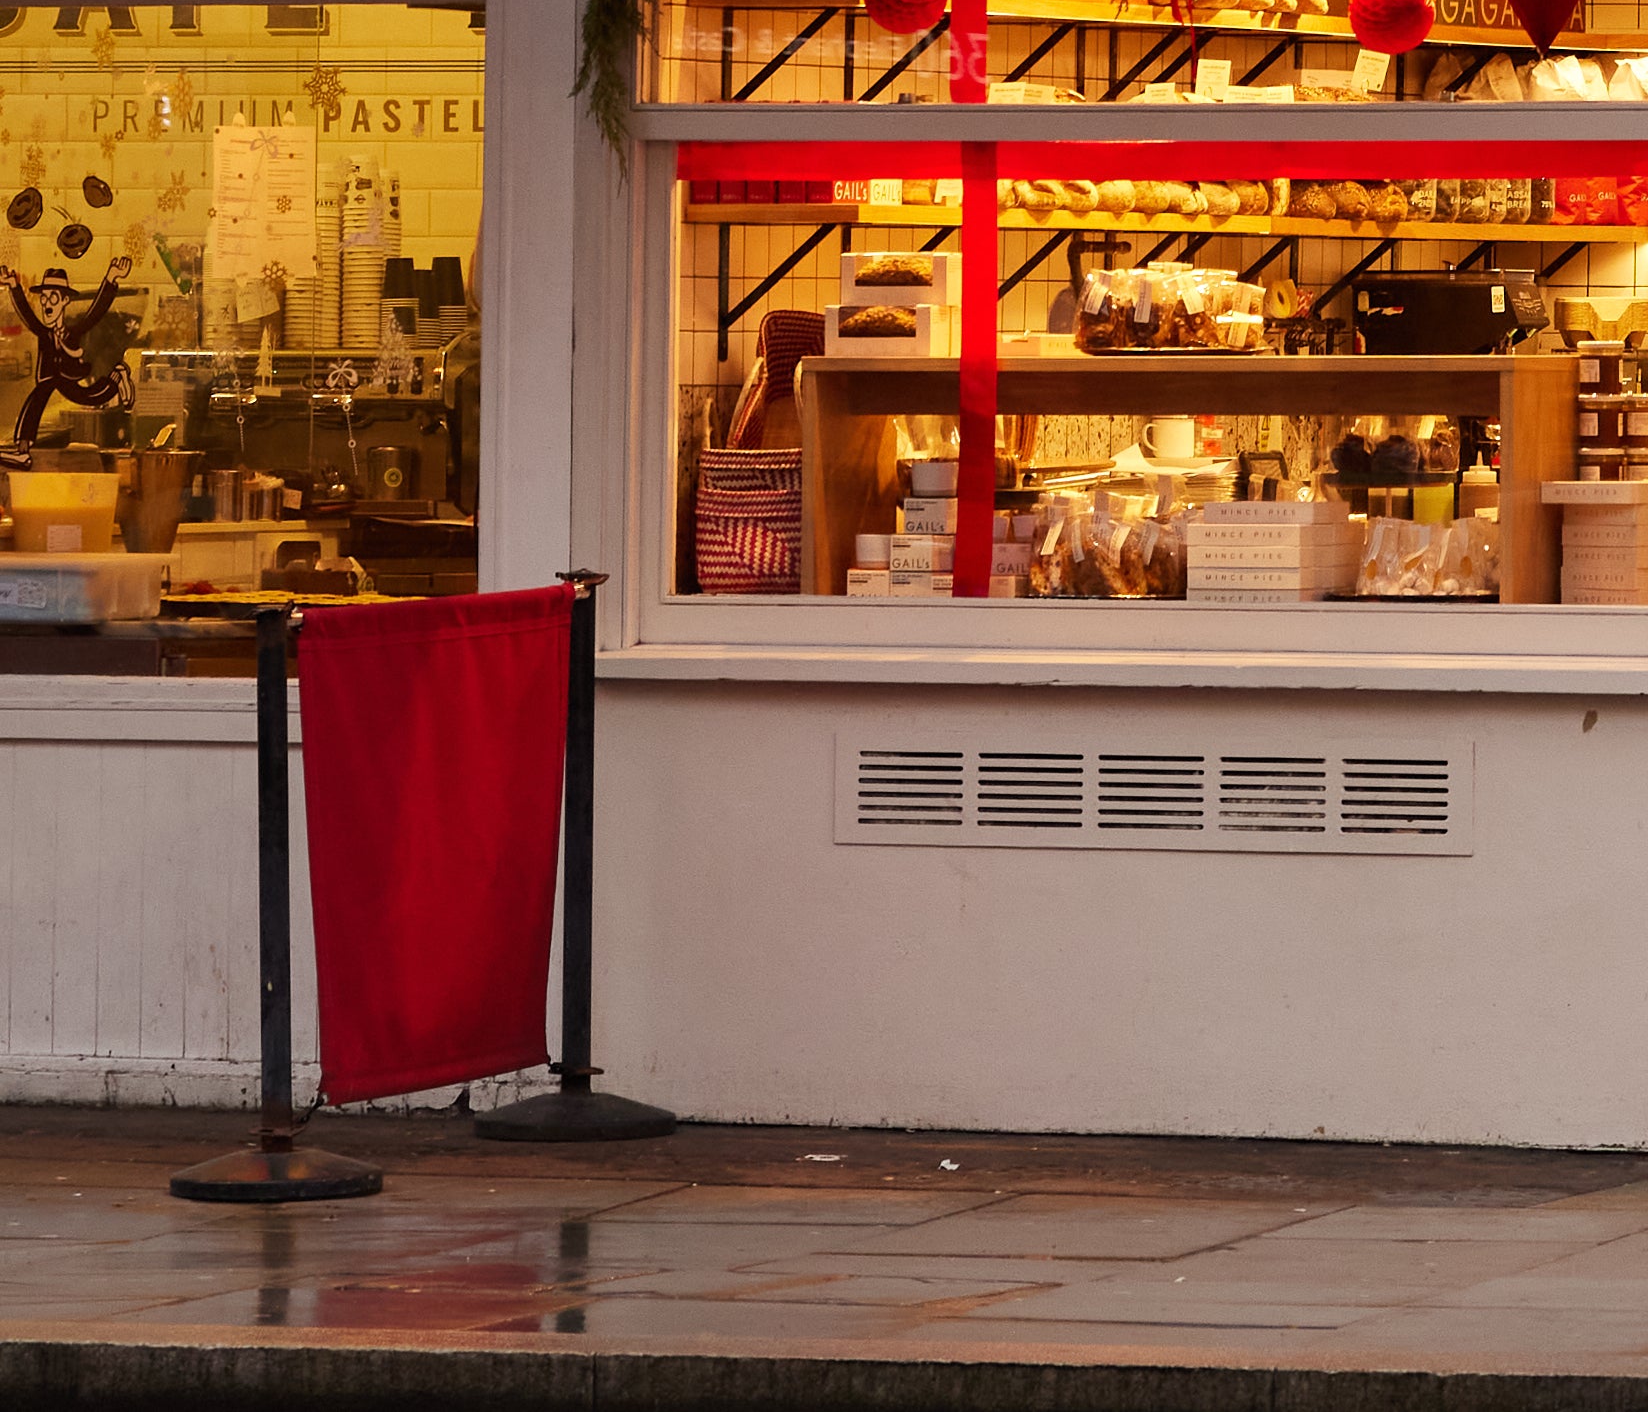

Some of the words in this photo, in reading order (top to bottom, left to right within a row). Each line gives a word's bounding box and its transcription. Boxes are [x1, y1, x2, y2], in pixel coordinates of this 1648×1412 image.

[93, 99, 294, 133] PREMIUM
[324, 99, 485, 134] PASTEL
[834, 181, 867, 201] GAIL's
[1221, 508, 1258, 516] MINCE
[1268, 508, 1297, 516] PIES
[905, 521, 945, 533] GAIL's
[892, 558, 930, 569] GAIL's
